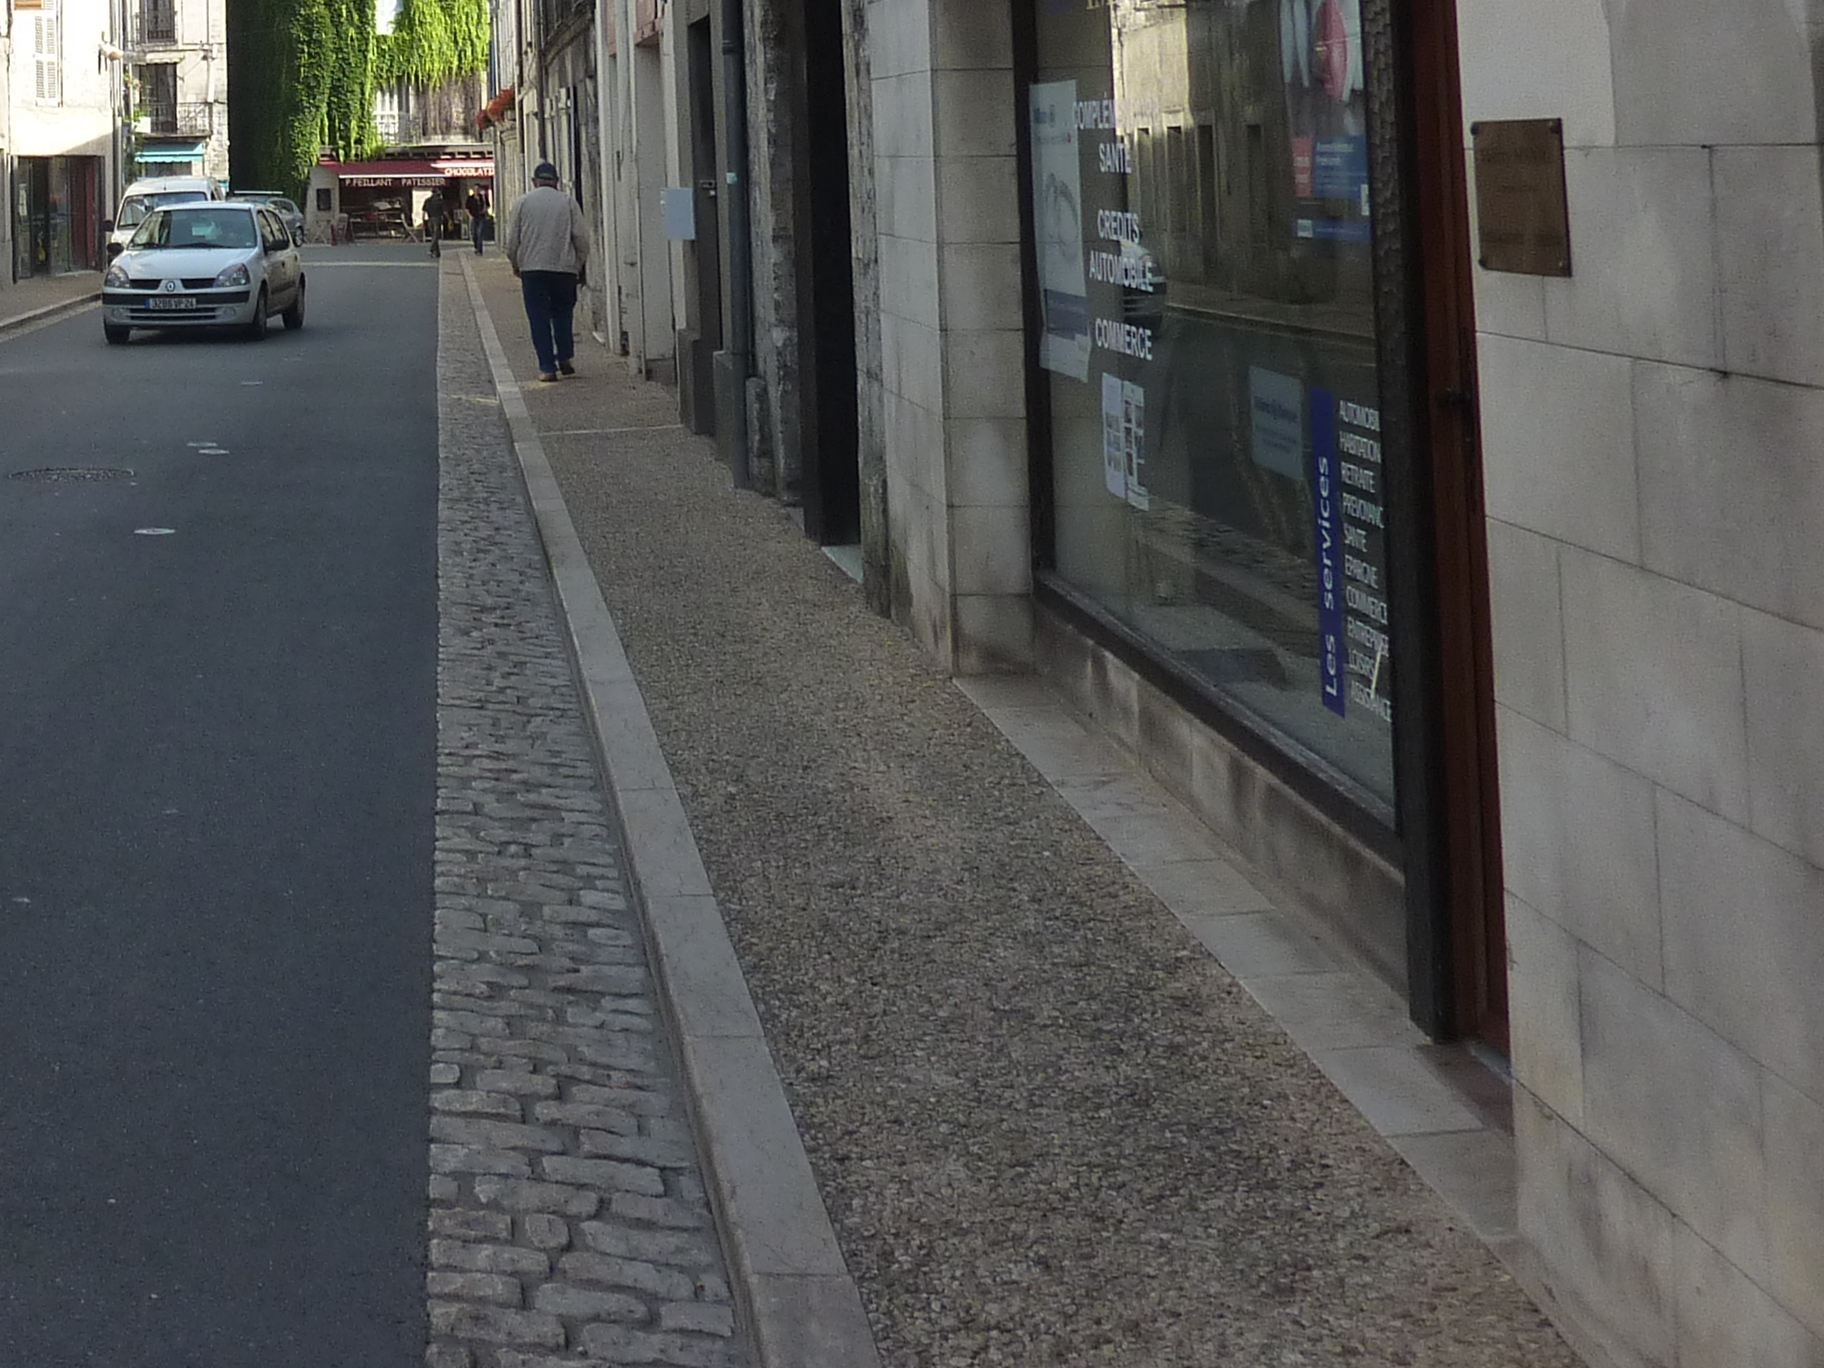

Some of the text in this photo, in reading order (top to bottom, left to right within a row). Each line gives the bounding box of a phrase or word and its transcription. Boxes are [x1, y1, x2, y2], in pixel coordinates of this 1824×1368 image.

[1089, 250, 1154, 293] AUTOMOBILE
[1095, 317, 1153, 361] COMMERCE
[1318, 456, 1338, 698] Les services
